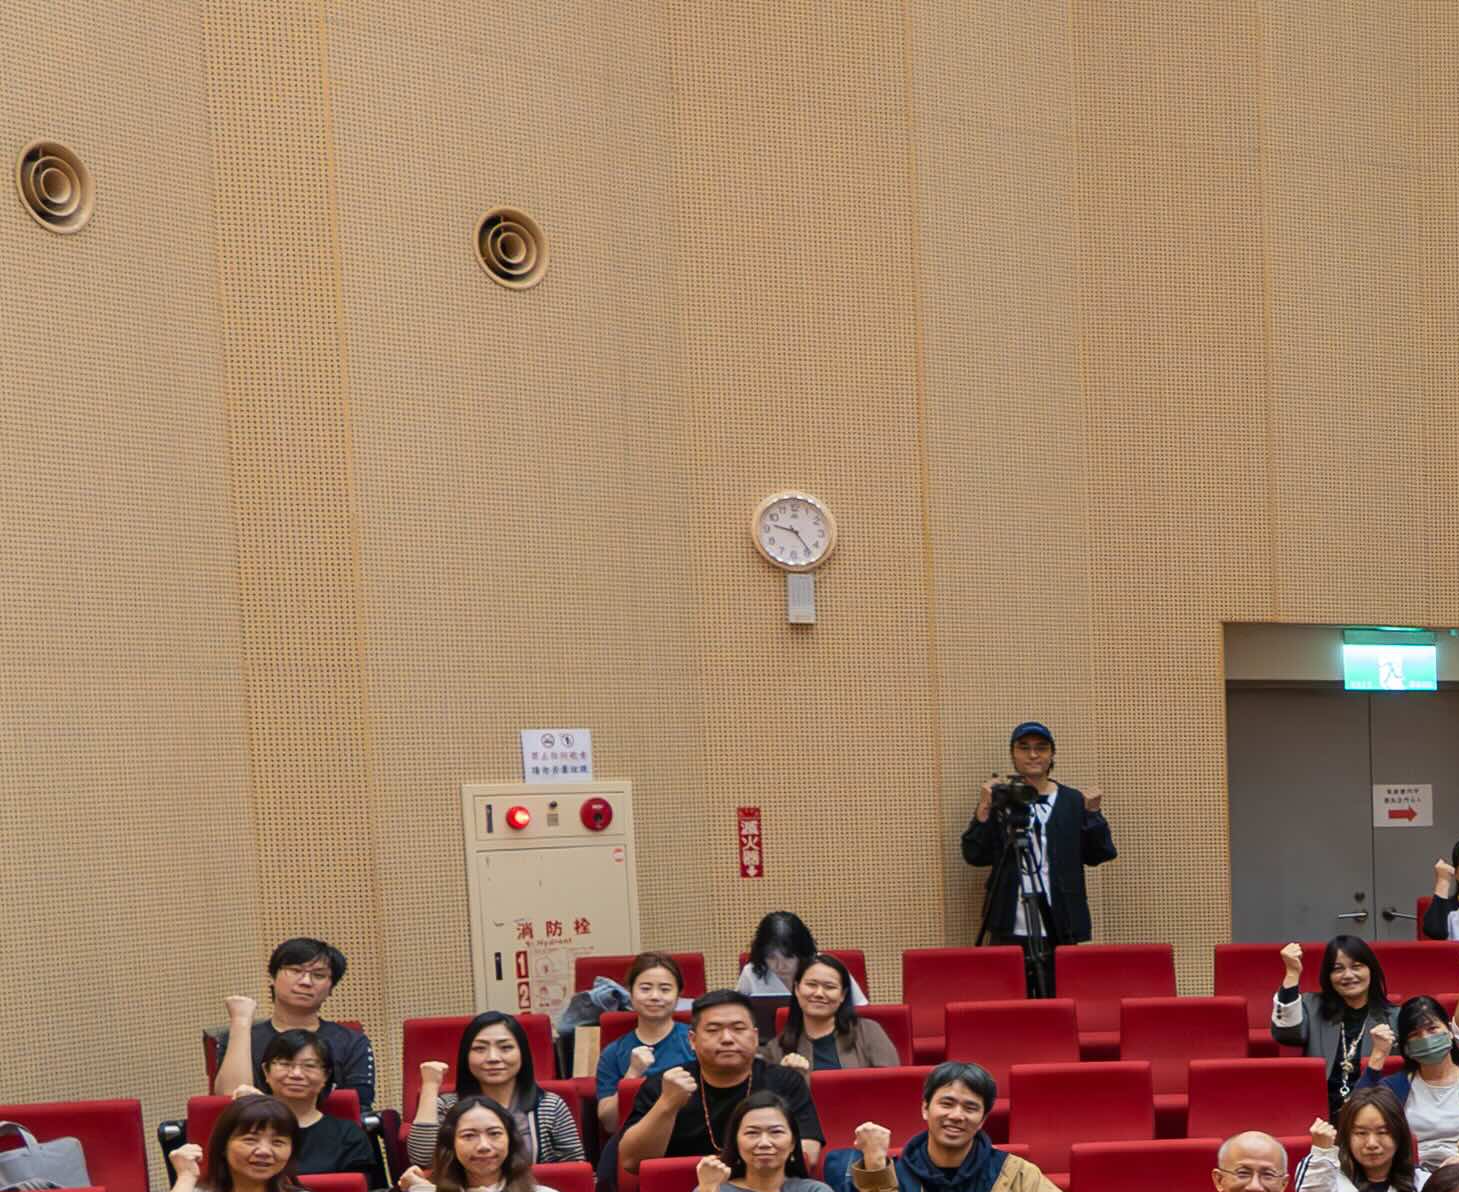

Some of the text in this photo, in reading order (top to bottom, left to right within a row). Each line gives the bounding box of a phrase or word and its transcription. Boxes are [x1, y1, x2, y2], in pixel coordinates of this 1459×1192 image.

[516, 917, 591, 940] 消防栓
[519, 983, 530, 1008] 2
